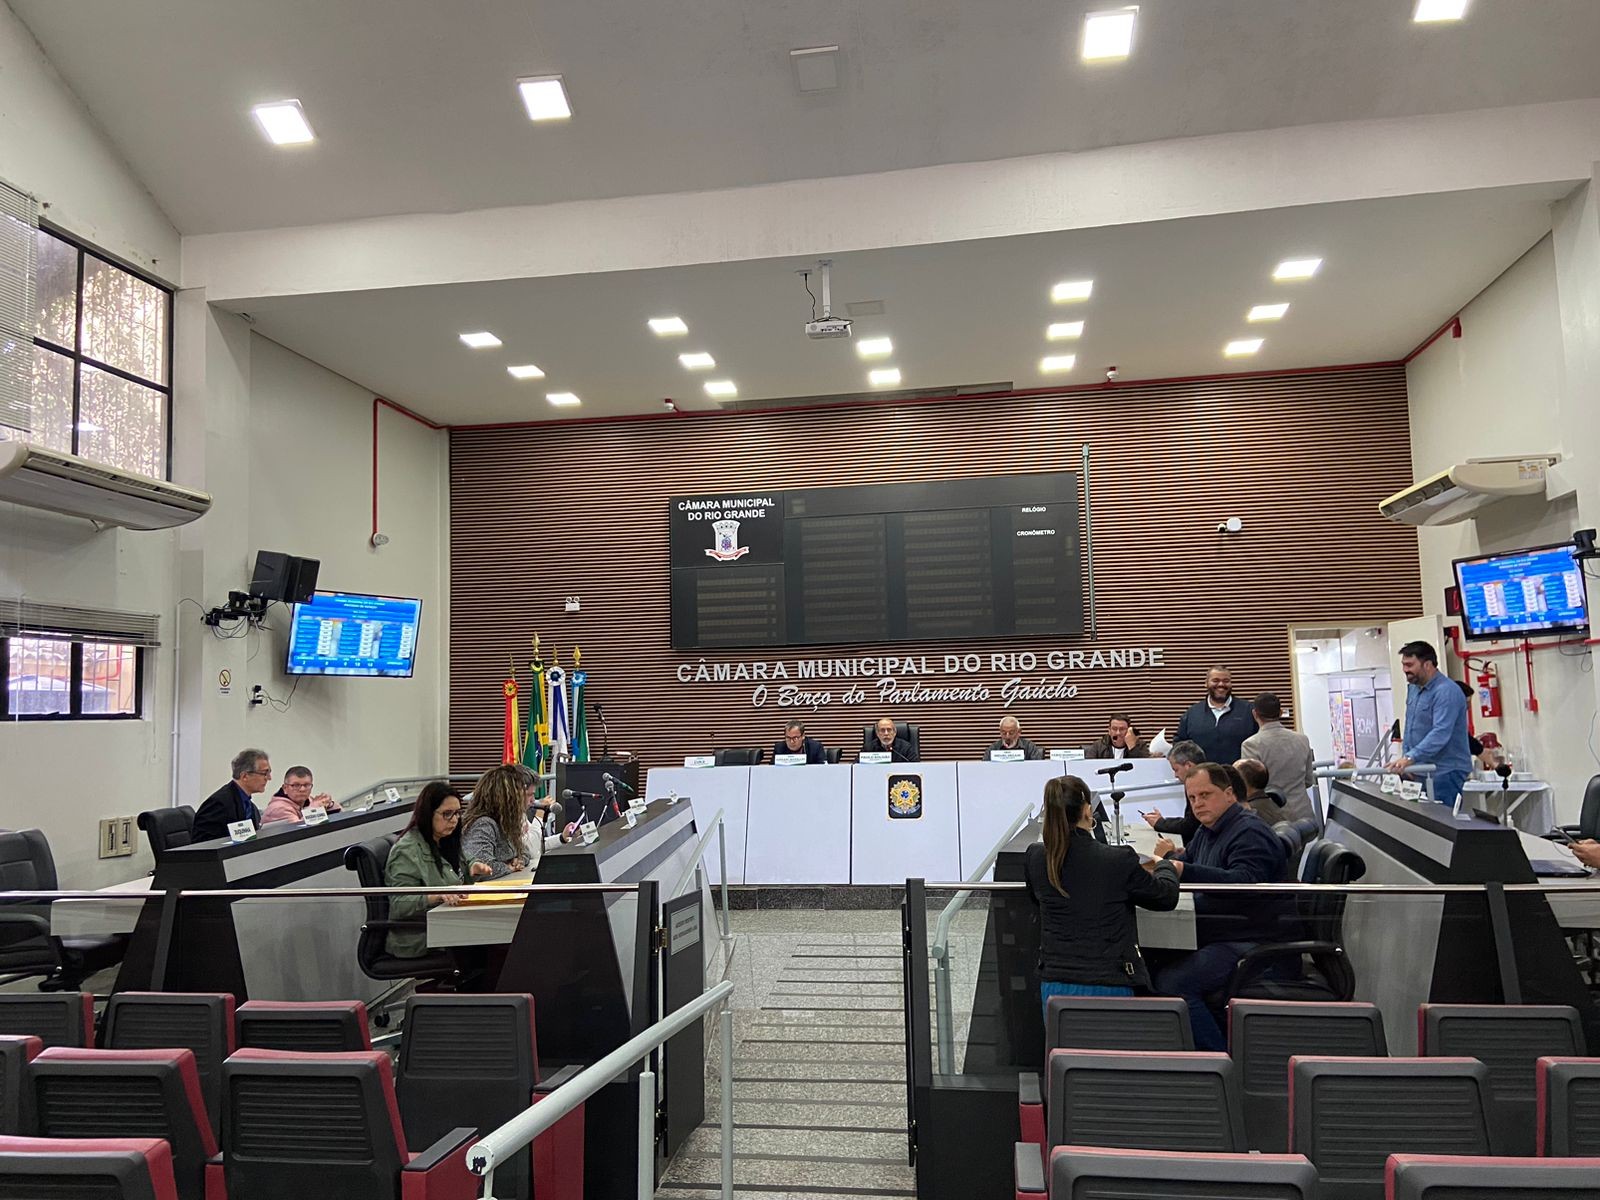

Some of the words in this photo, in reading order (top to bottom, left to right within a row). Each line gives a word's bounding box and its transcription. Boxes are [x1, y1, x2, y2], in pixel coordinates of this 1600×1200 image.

[678, 500, 720, 511] CÂMARA
[722, 498, 775, 509] MUNICIPAL
[687, 512, 703, 521] DO
[704, 511, 722, 520] RIO
[723, 509, 766, 519] GRANDE
[1016, 529, 1056, 537] CRONÔMETRO
[676, 658, 789, 683] CÂMARA
[798, 656, 936, 679] MUNICIPAL
[944, 653, 981, 674] DO
[990, 651, 1038, 673] RIO
[1046, 648, 1166, 671] GRANDE
[752, 684, 769, 708] O
[777, 684, 832, 712] Berço
[842, 684, 867, 705] do
[875, 677, 991, 704] Parlamento
[1000, 676, 1079, 709] Gaúcho
